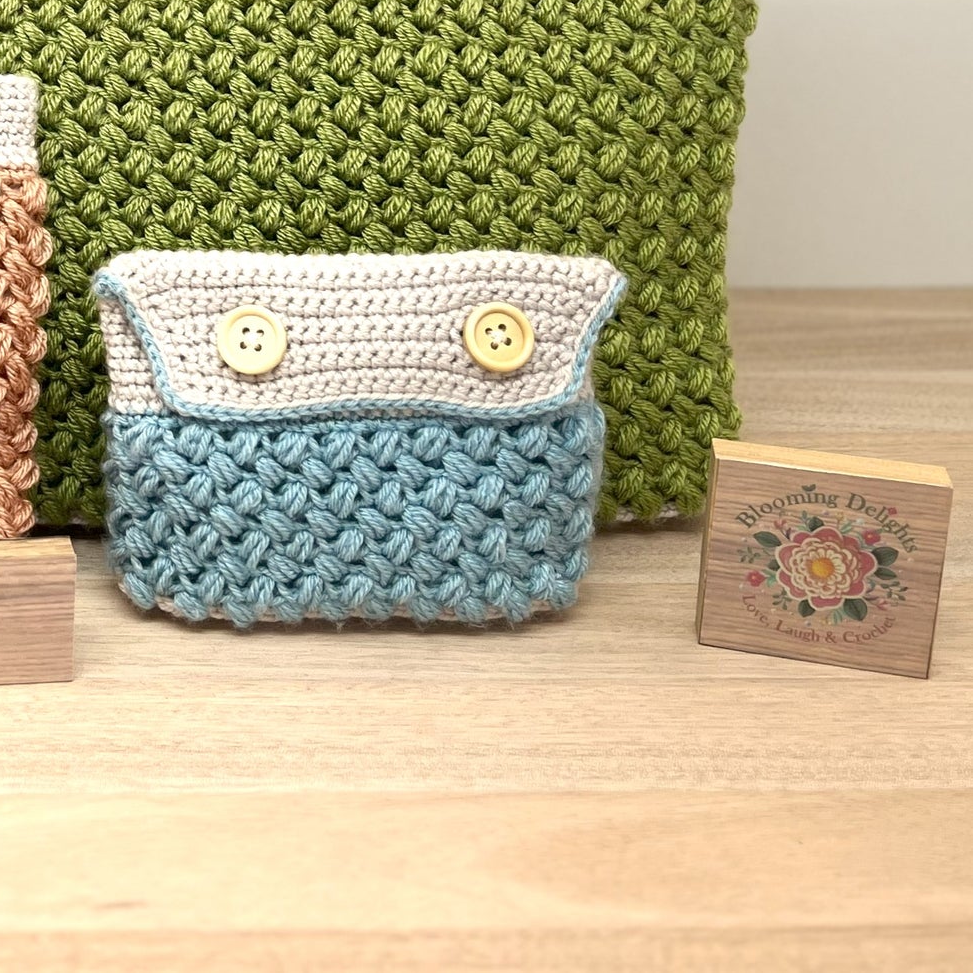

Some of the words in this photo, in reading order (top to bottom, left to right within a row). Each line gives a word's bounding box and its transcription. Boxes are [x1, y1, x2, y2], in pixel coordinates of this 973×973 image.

[735, 486, 840, 528] Blooming
[845, 492, 918, 554] Delights
[775, 619, 821, 644] Laugh
[824, 631, 837, 644] &
[842, 616, 897, 644] Crochet
